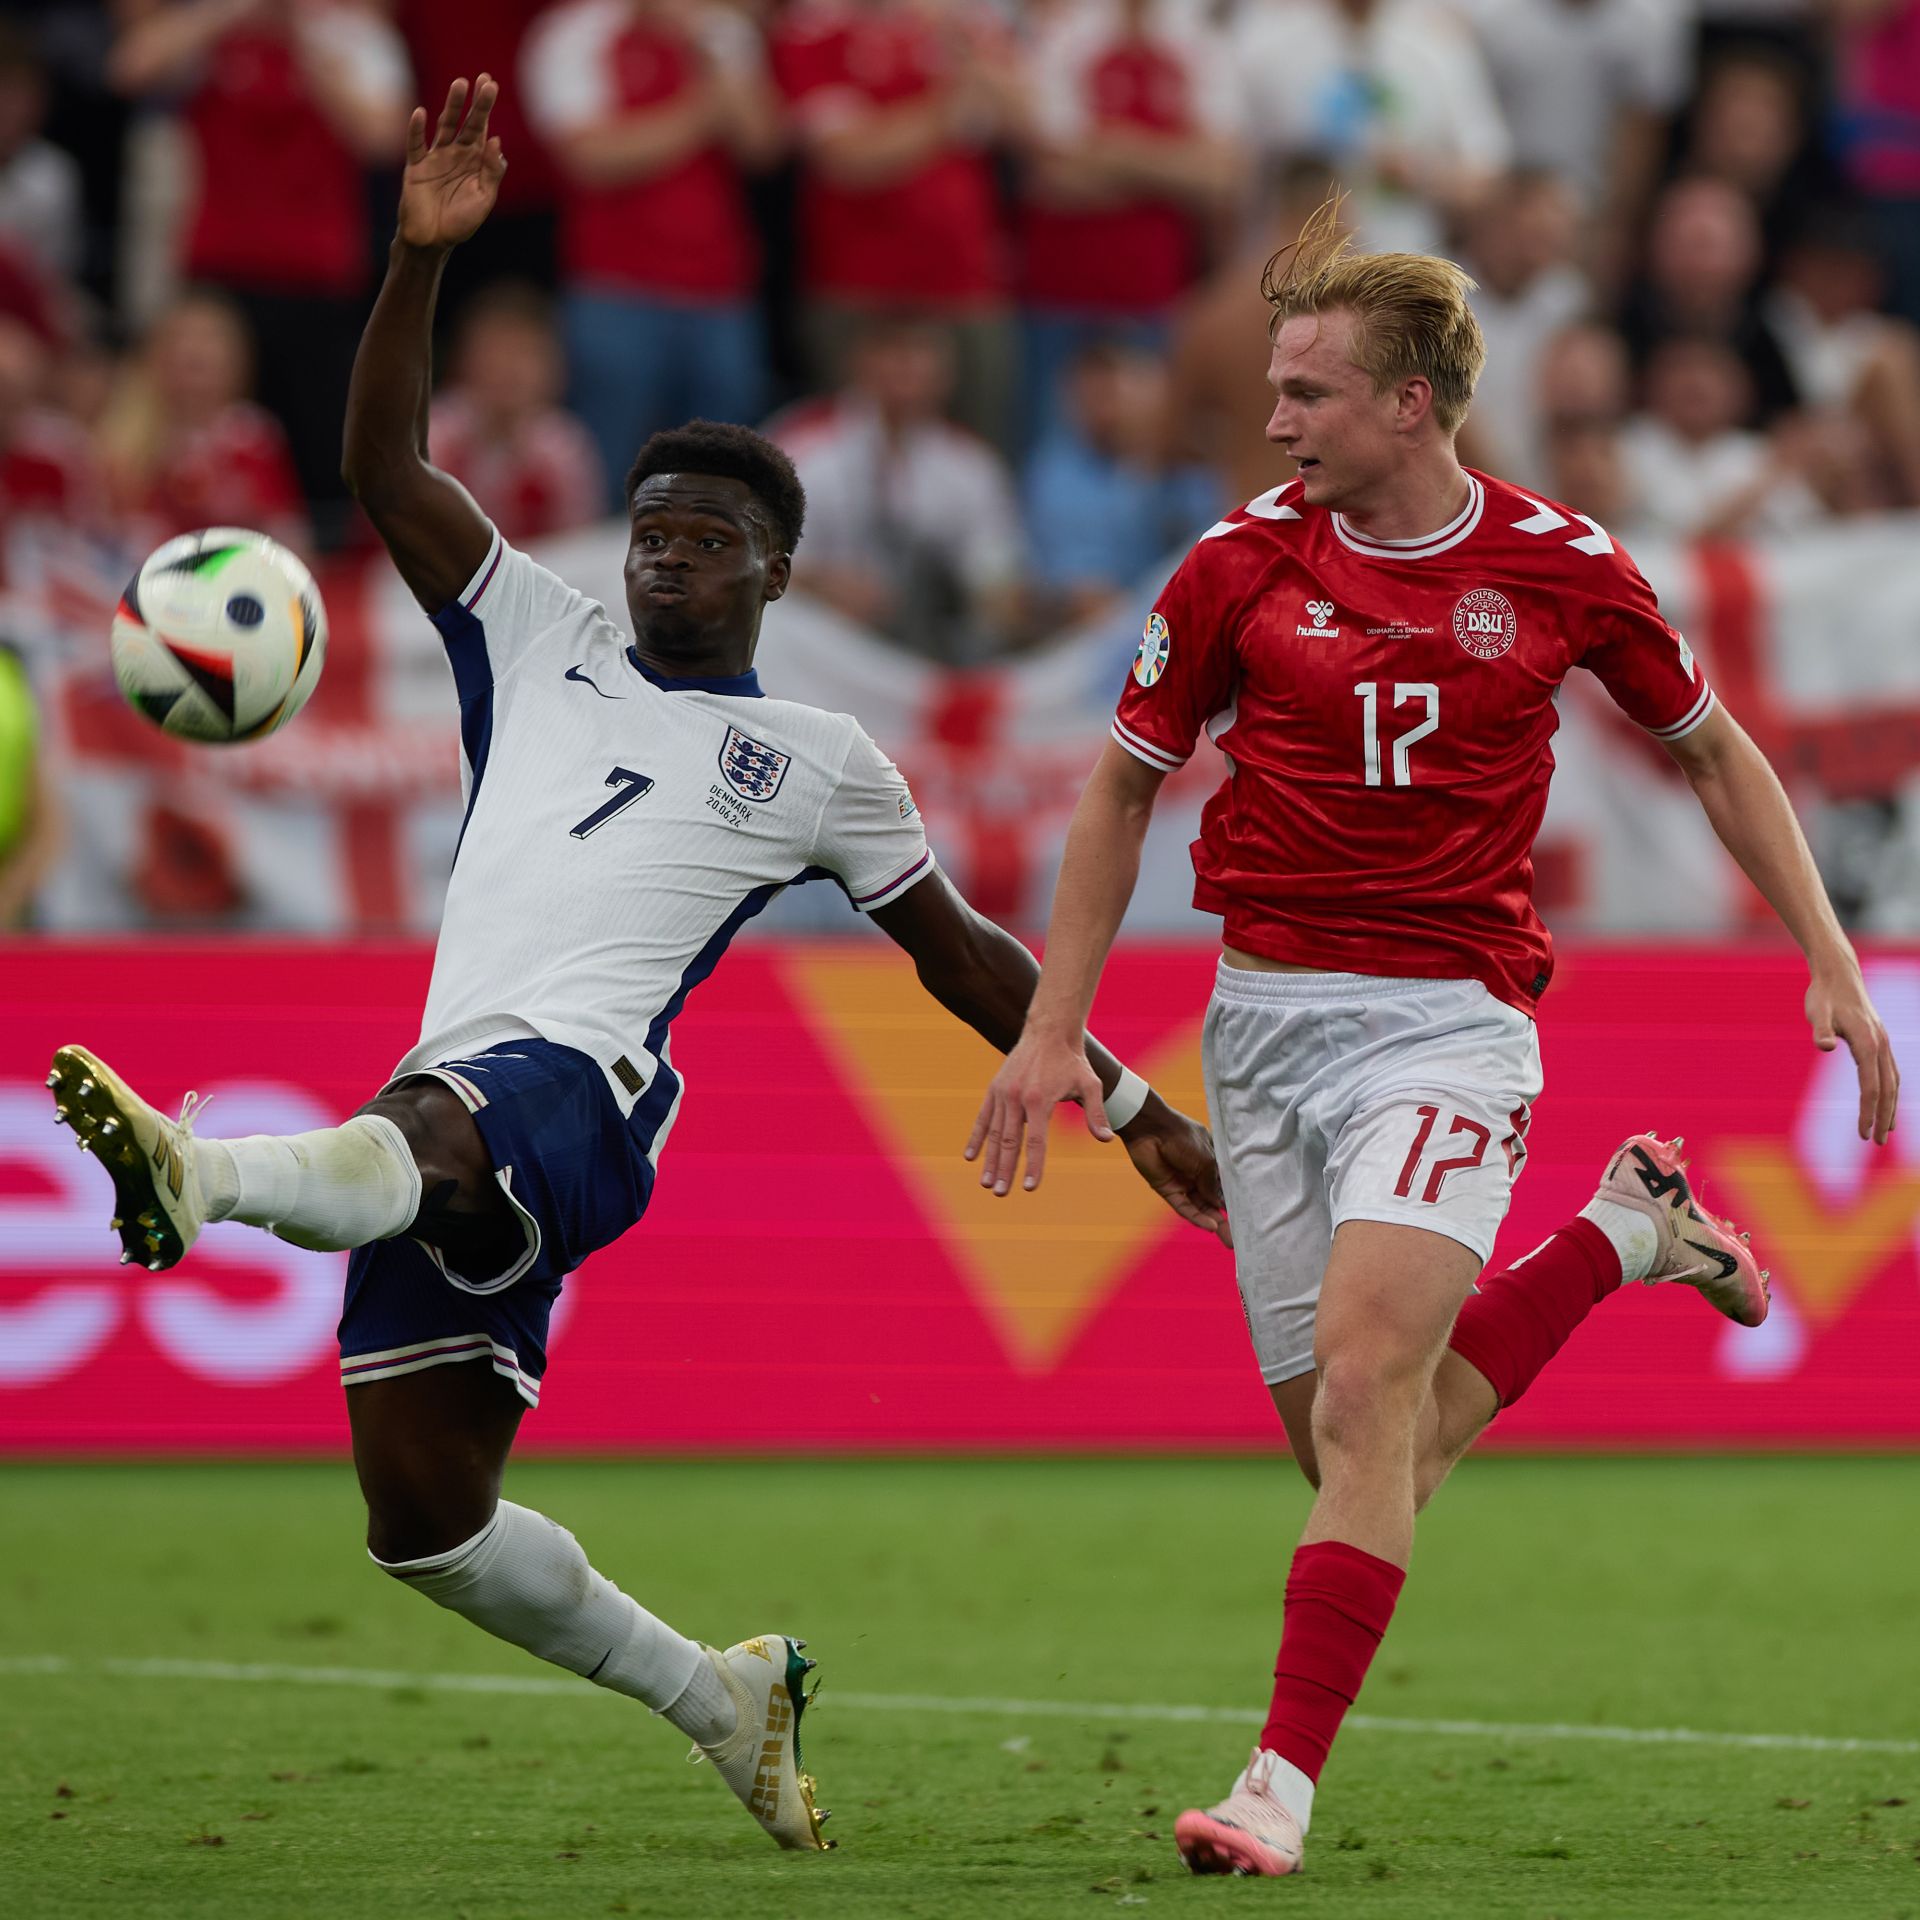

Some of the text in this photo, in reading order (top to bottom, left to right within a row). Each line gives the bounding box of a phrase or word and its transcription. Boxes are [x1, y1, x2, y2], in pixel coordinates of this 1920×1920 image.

[1296, 624, 1340, 638] hummel
[1366, 627, 1396, 635] DENMARK
[1404, 626, 1435, 634] ENGLAND
[1455, 607, 1471, 648] DANSK
[1500, 612, 1515, 649] UNION
[1466, 612, 1504, 634] DBU
[1473, 646, 1499, 657] 1889
[569, 766, 655, 840] 7
[705, 796, 742, 828] 20.06.24
[709, 784, 753, 823] DENMARK
